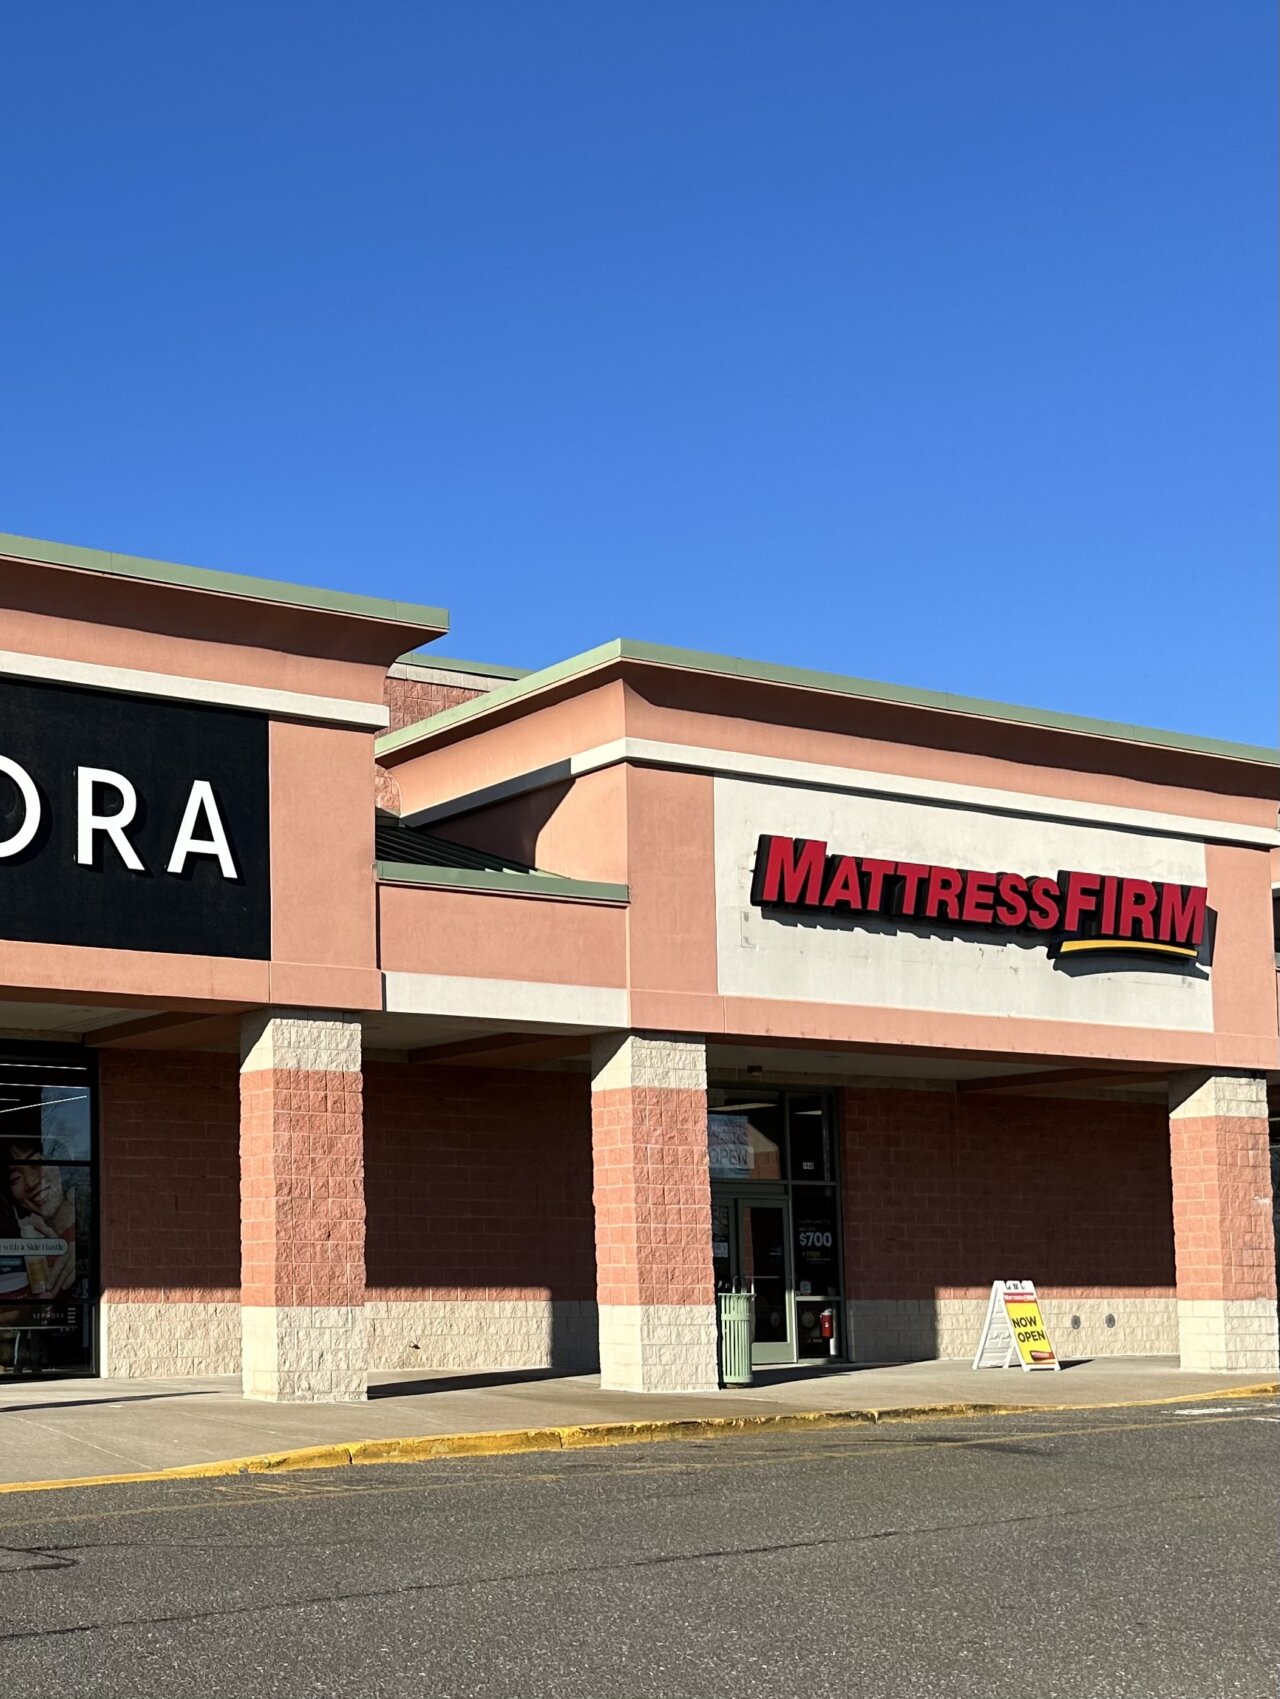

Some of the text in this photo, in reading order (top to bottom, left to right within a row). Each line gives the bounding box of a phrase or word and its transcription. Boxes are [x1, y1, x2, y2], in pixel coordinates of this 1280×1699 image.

[710, 1148, 748, 1165] OPEN
[4, 1242, 19, 1251] with
[26, 1242, 40, 1251] Side
[42, 1243, 65, 1251] Hustle
[799, 1232, 832, 1247] $700
[1011, 1316, 1037, 1328] NOW
[1017, 1329, 1046, 1343] OPEN
